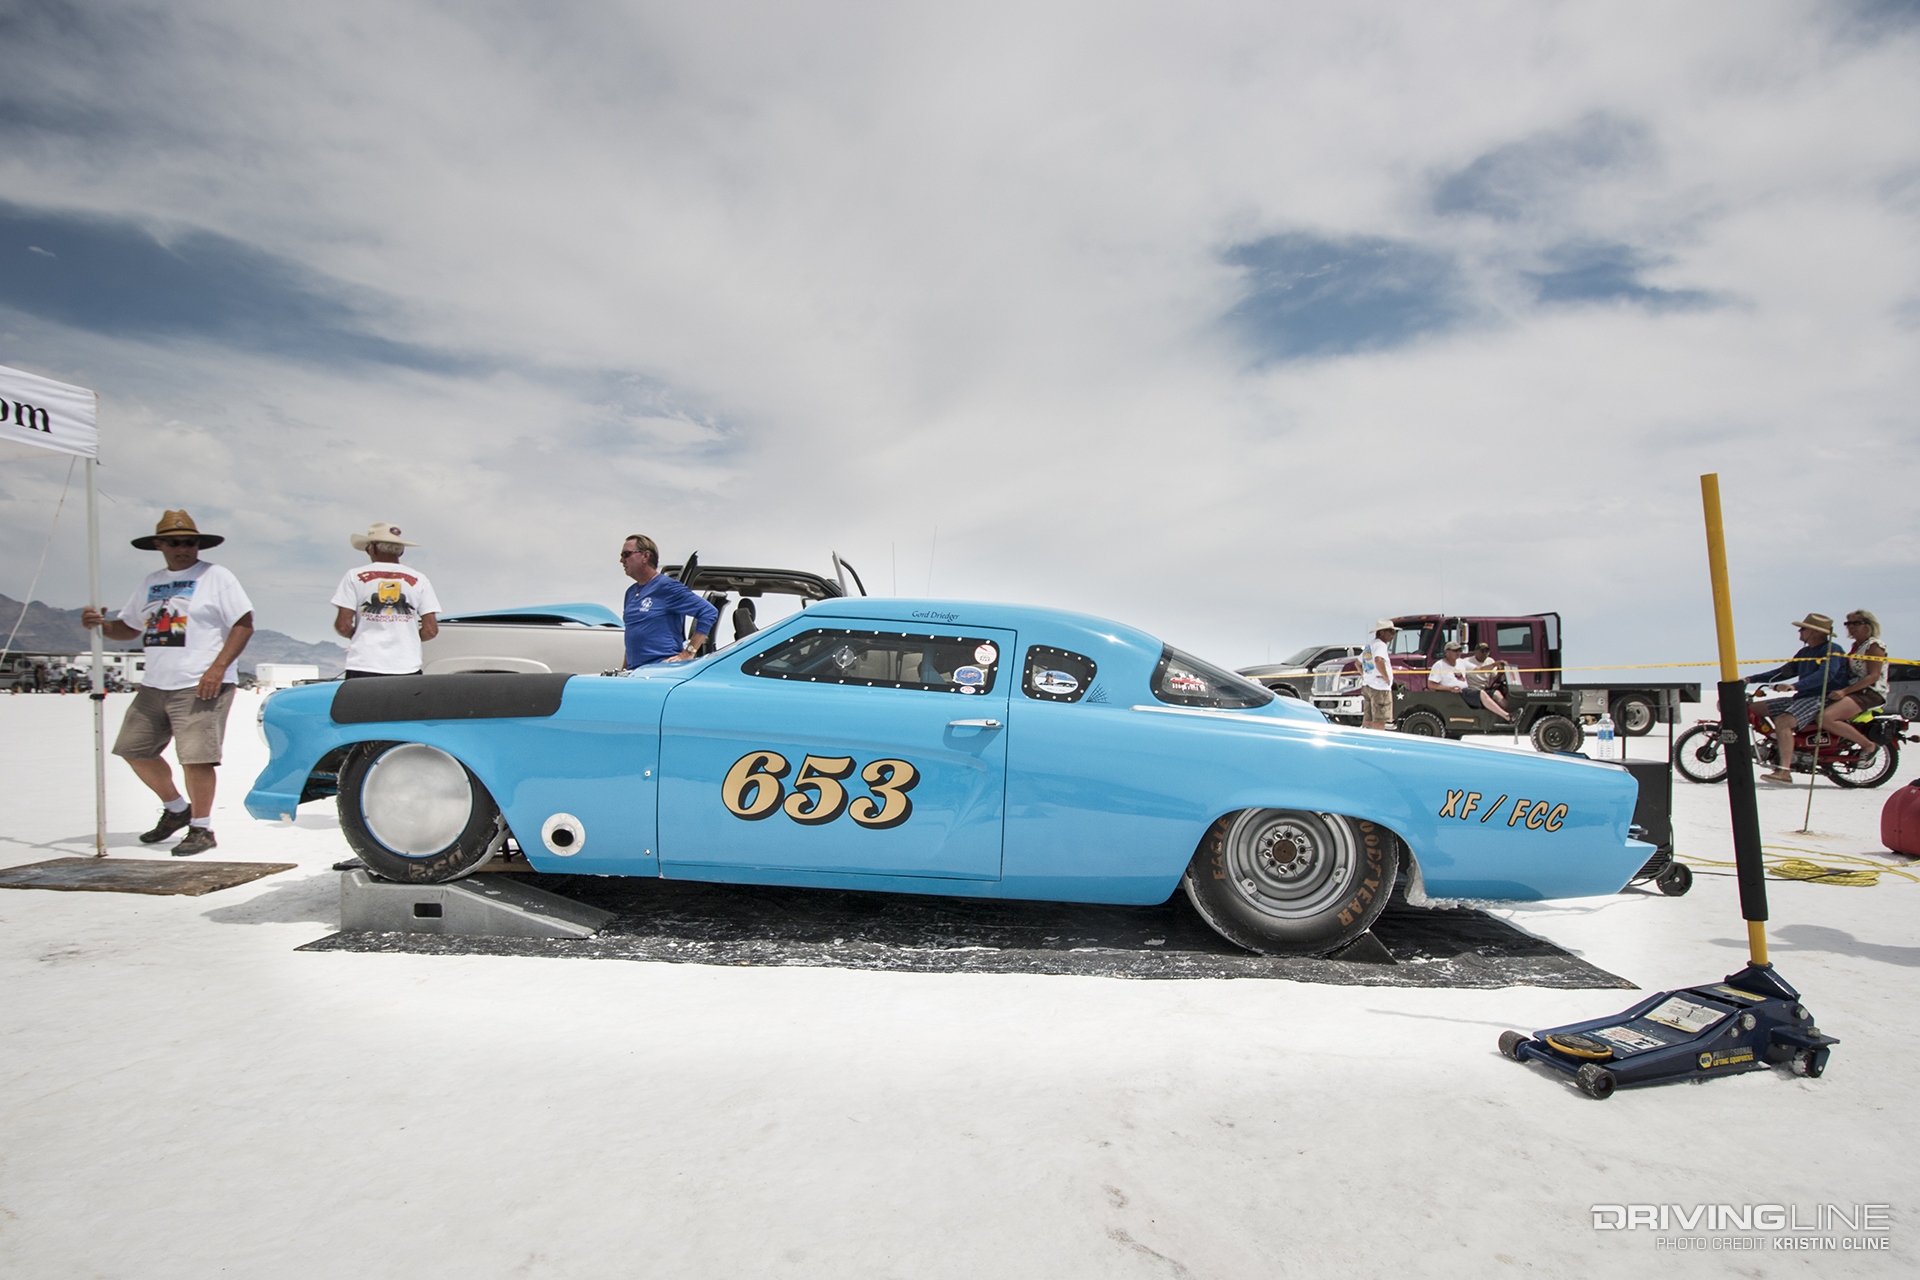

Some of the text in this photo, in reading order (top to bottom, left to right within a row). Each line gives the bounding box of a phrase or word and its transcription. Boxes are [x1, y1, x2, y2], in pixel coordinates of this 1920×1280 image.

[911, 610, 960, 623] Gord Driedger
[721, 750, 921, 830] 653
[1438, 789, 1482, 821] XF
[1507, 798, 1569, 832] FCC
[1210, 817, 1231, 881] EAGLE
[1713, 1046, 1754, 1060] PROFESSIONAL
